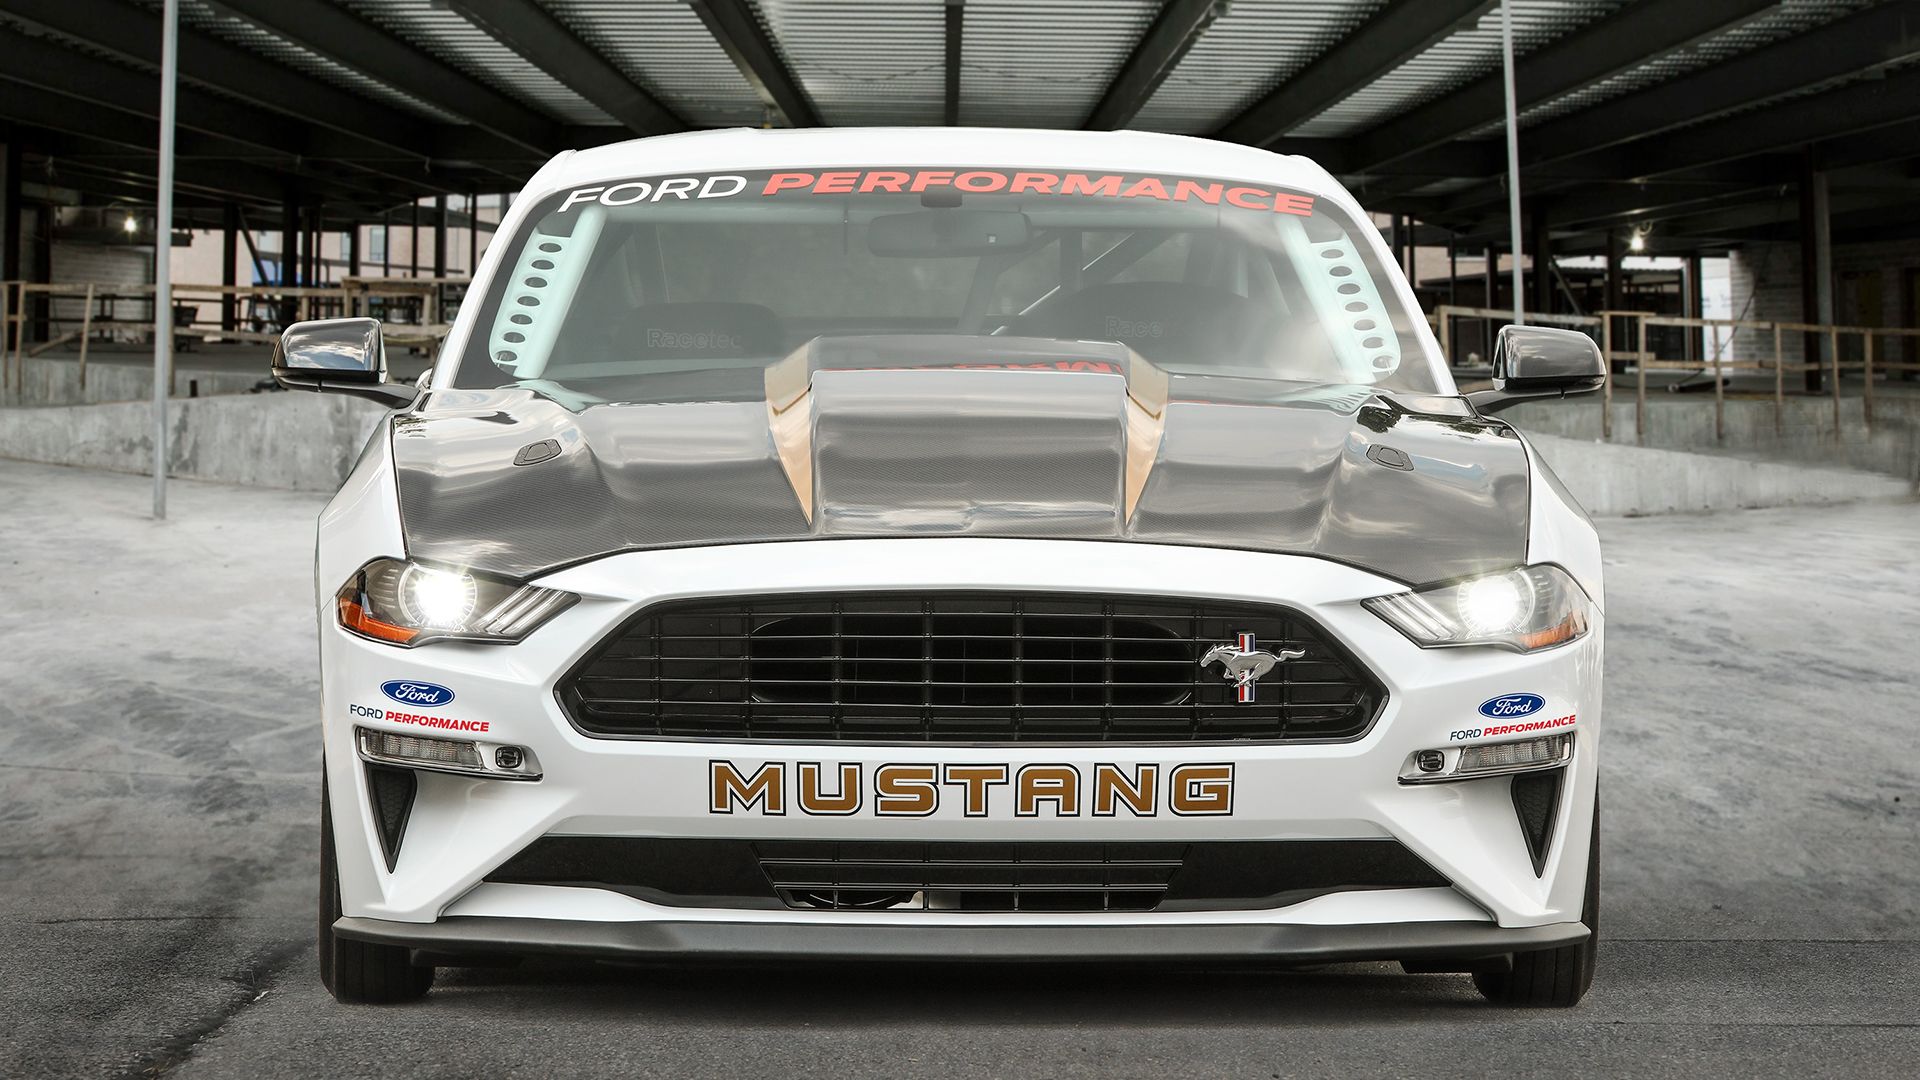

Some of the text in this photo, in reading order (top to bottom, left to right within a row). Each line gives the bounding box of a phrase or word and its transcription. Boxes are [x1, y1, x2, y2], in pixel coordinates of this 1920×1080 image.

[557, 171, 1314, 217] FORD PERFORMANCE
[395, 684, 440, 704] Ford
[1492, 697, 1532, 715] Ford
[350, 704, 490, 732] FORD PERFORMANCE
[1450, 714, 1576, 741] FORD PERFORMANCE
[708, 759, 1235, 818] MUSTANG
